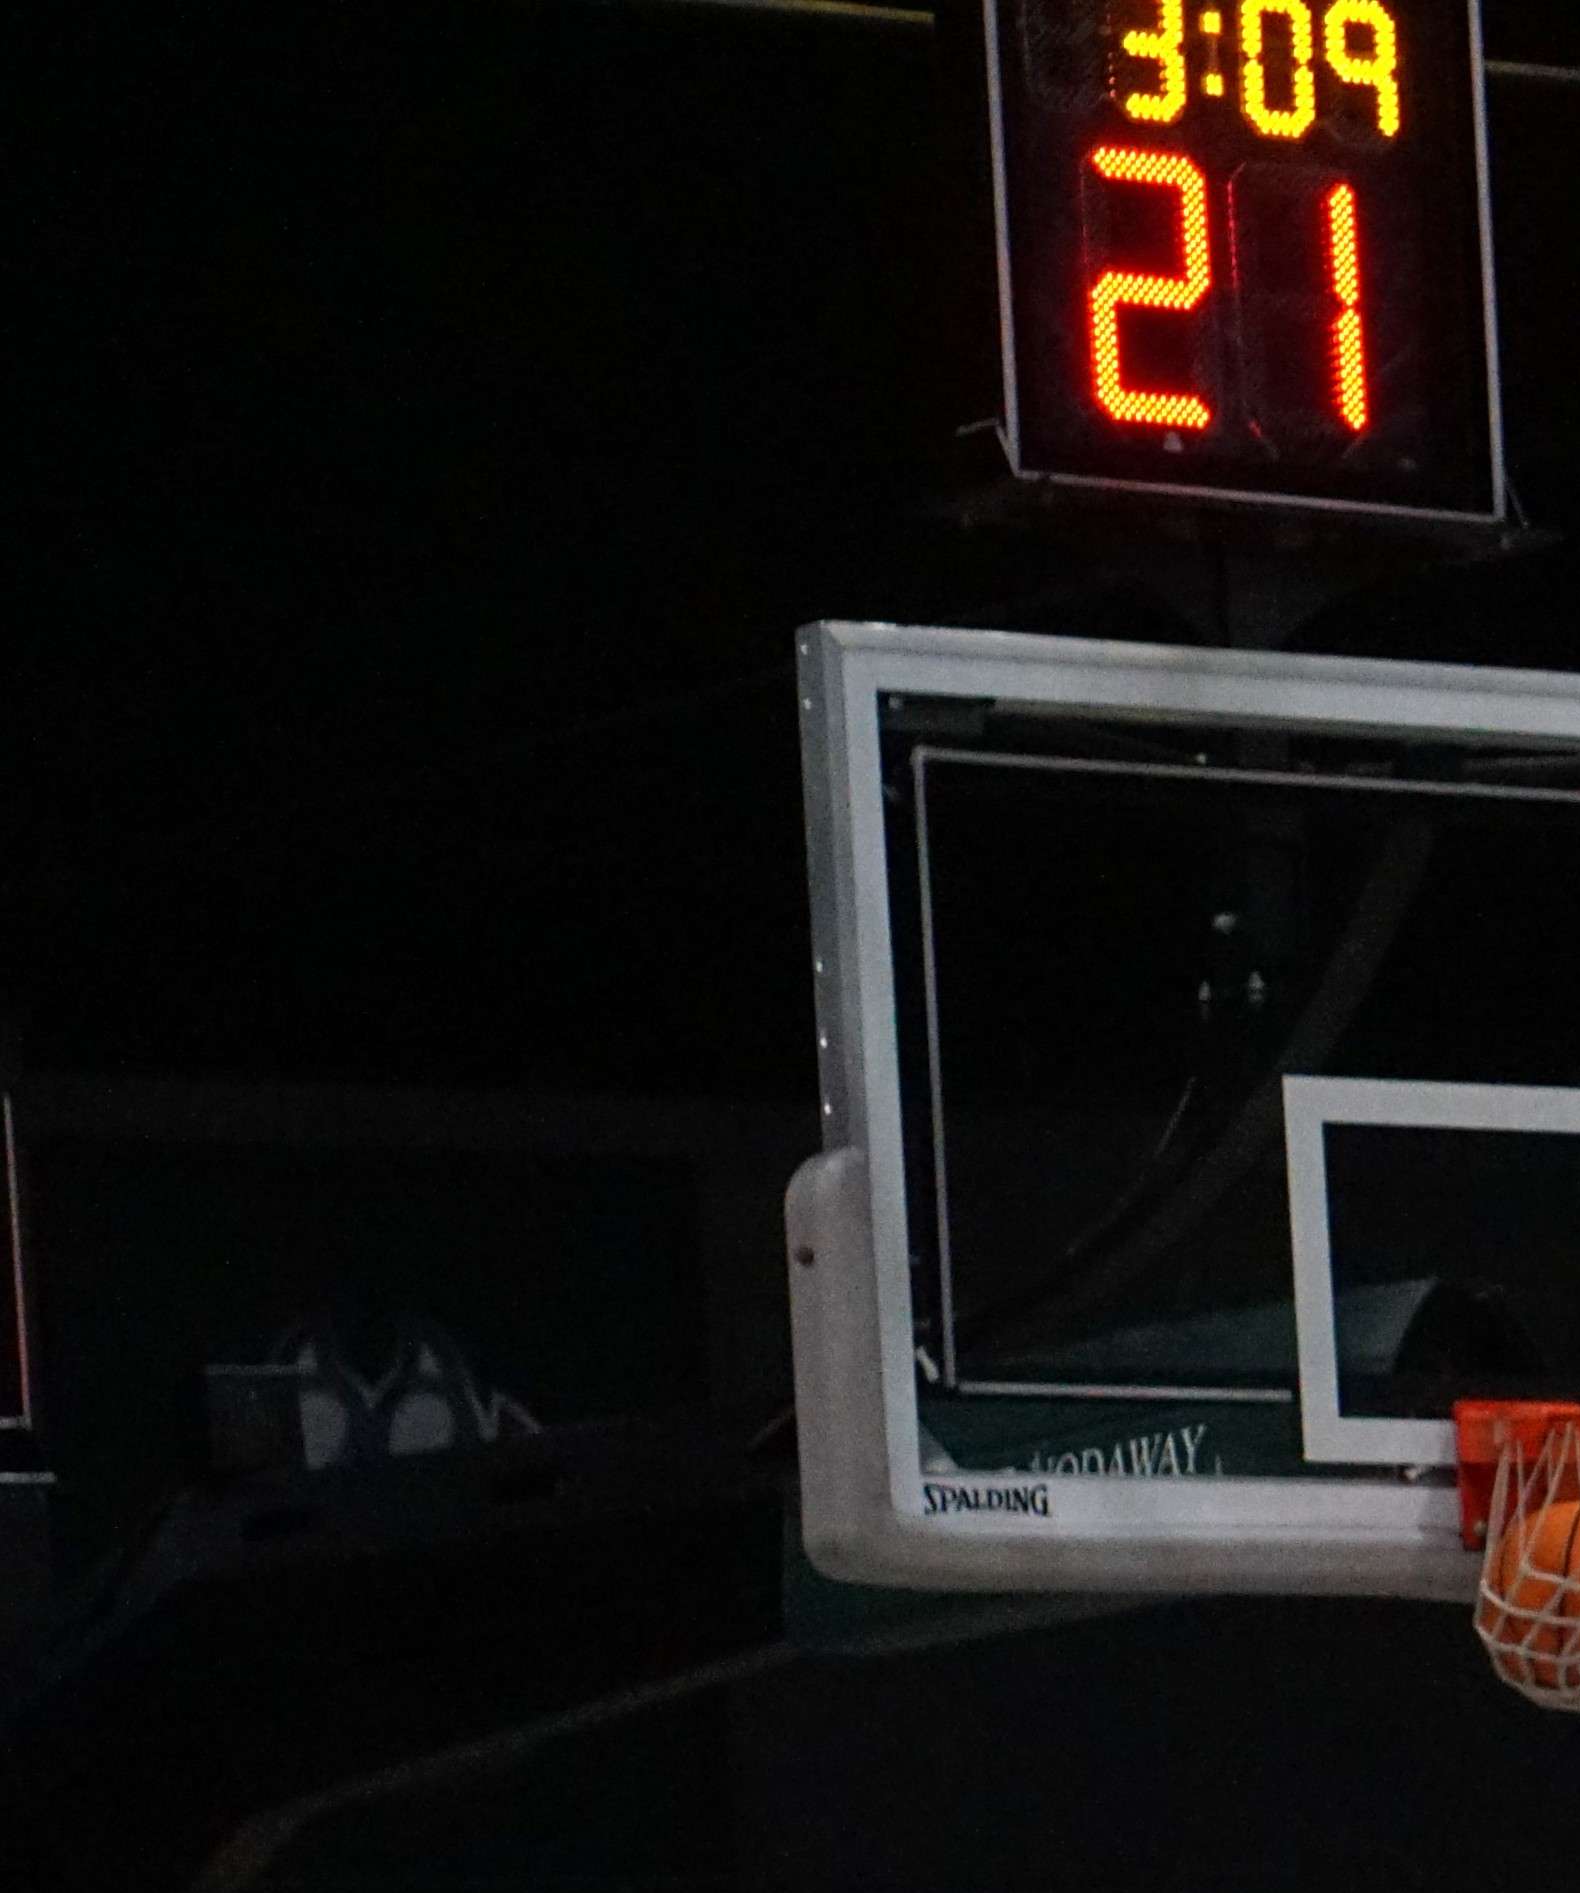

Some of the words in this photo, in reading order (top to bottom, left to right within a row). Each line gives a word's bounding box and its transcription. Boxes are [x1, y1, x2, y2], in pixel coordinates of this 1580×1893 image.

[1122, 0, 1399, 138] 3:09
[1090, 146, 1368, 430] 21
[924, 1483, 1050, 1516] SPALDING
